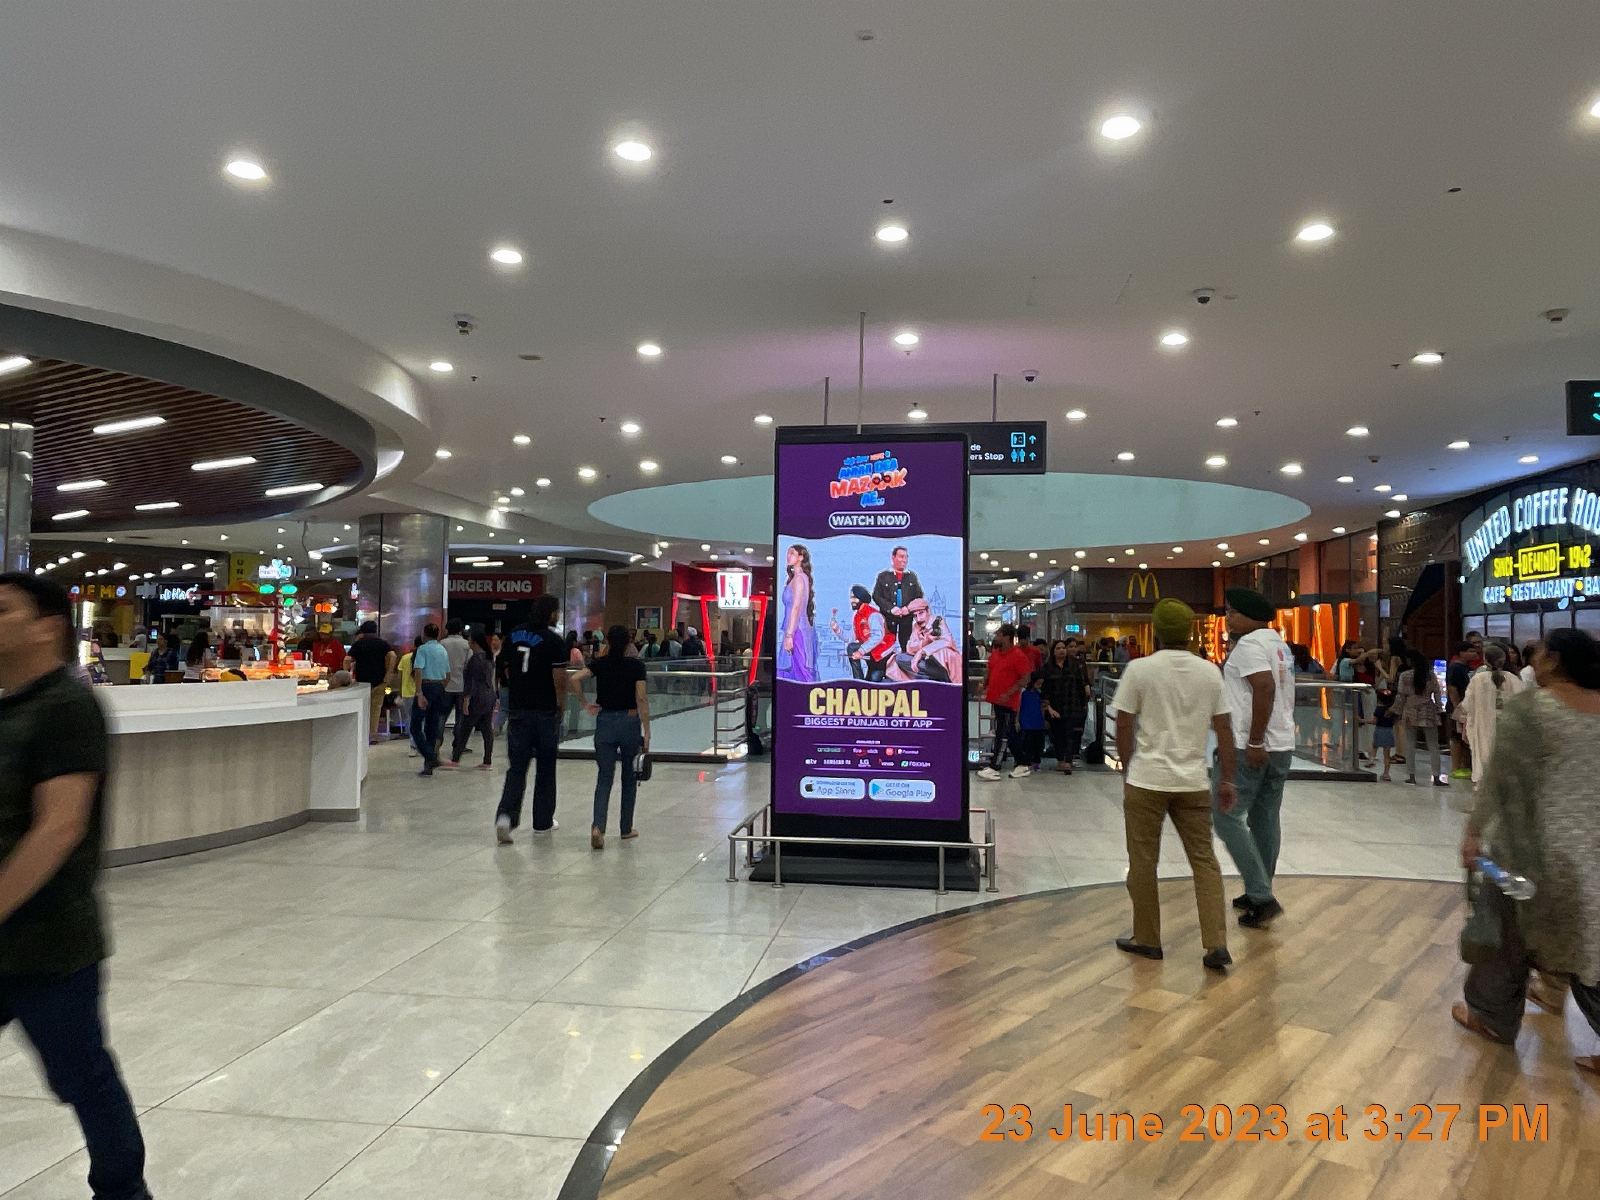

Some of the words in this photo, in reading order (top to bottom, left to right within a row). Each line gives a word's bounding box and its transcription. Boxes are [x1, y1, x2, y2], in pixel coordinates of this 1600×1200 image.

[984, 452, 1005, 461] Stop
[831, 515, 875, 526] WATCH
[877, 515, 908, 526] NOW
[1464, 505, 1511, 570] UNITED
[1514, 487, 1569, 533] COFFEE
[496, 580, 532, 593] KING
[1483, 585, 1506, 604] CAFE
[1511, 578, 1576, 602] RESTAURANT
[516, 645, 531, 672] 7
[809, 687, 928, 717] CHAUPAL
[804, 717, 846, 726] BIGGEST
[848, 718, 889, 727] PUNJABI
[891, 719, 910, 728] OTT
[913, 720, 934, 728] APP
[816, 786, 833, 795] App
[886, 788, 914, 798] Google
[916, 789, 932, 799] Play
